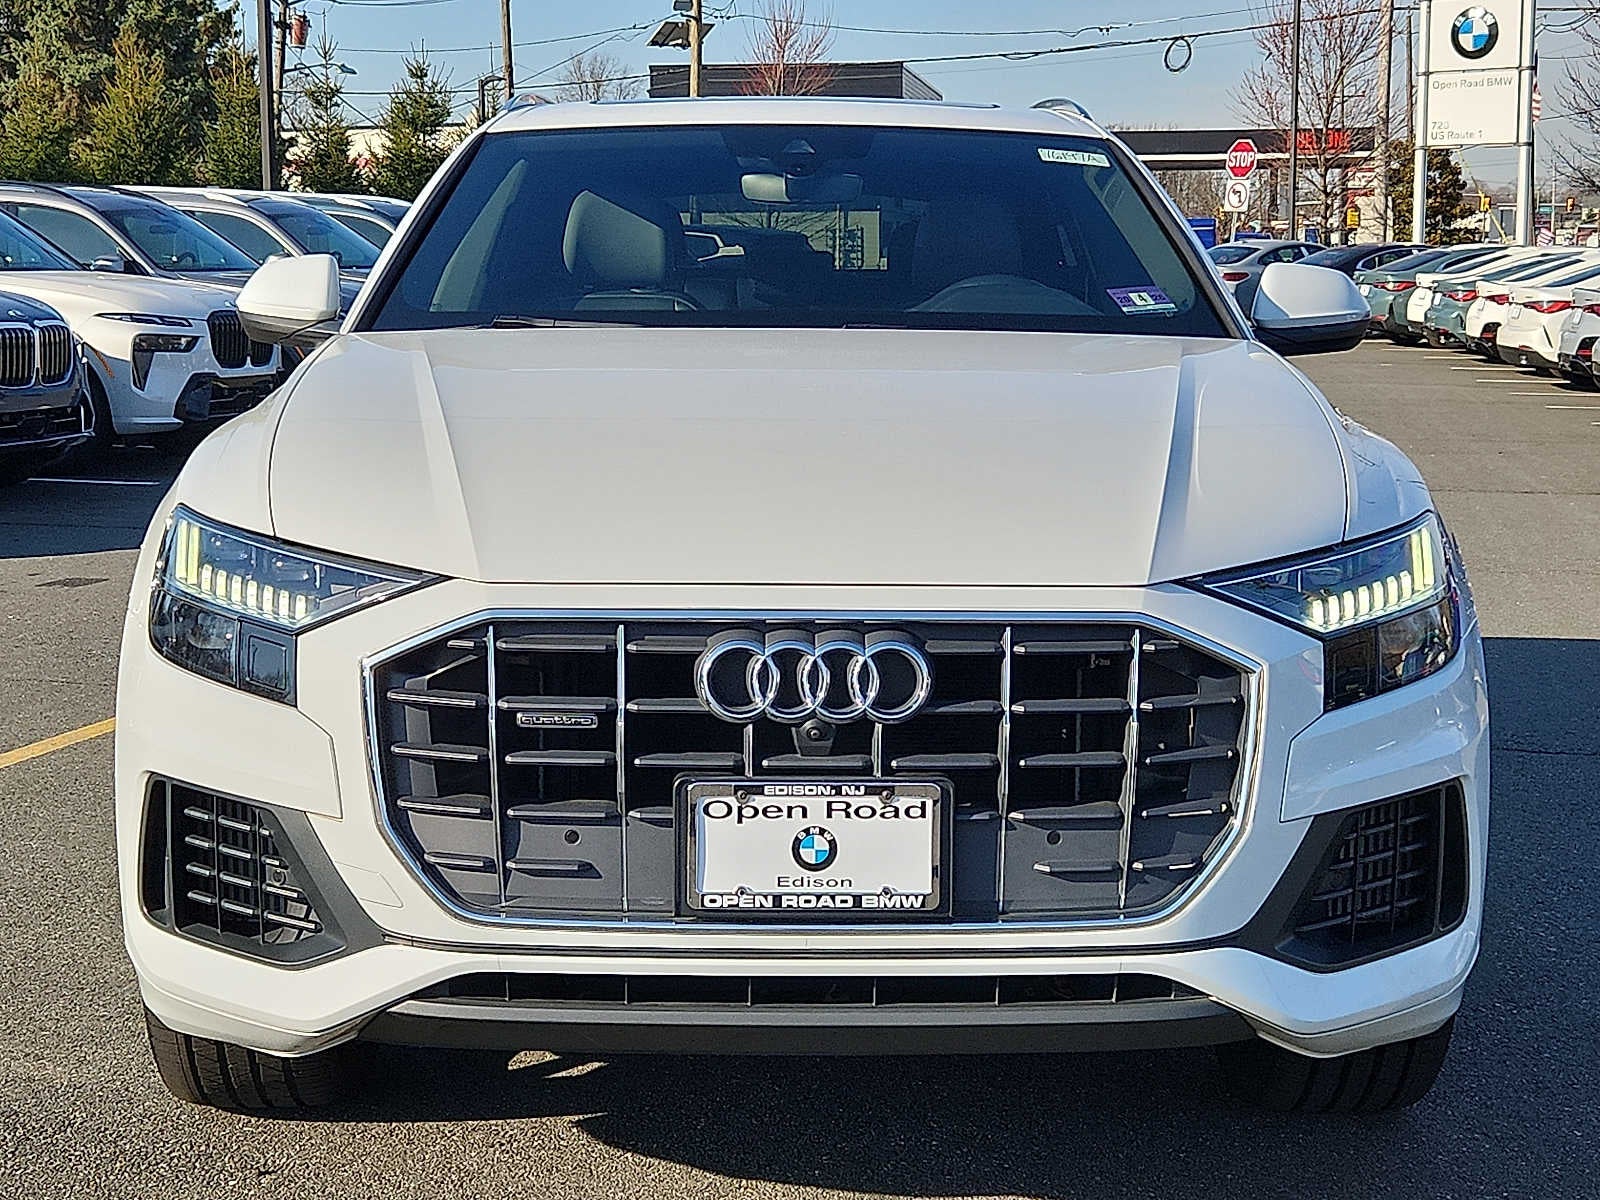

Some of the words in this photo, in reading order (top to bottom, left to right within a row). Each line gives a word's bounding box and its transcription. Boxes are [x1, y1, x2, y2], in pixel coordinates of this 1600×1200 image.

[1432, 80, 1458, 90] Open
[1460, 78, 1485, 88] Road
[1487, 77, 1513, 87] BMW
[1431, 131, 1445, 140] US
[1447, 130, 1475, 140] Route
[1229, 152, 1255, 168] STOP
[521, 715, 592, 725] quattro
[763, 785, 836, 797] EDISON,
[841, 785, 866, 796] NJ
[702, 801, 809, 824] Open
[826, 801, 928, 820] Road
[797, 827, 833, 841] BMW
[777, 876, 853, 888] Edison
[703, 895, 775, 908] OPEN
[781, 895, 855, 908] ROAD
[861, 895, 924, 908] BMW
